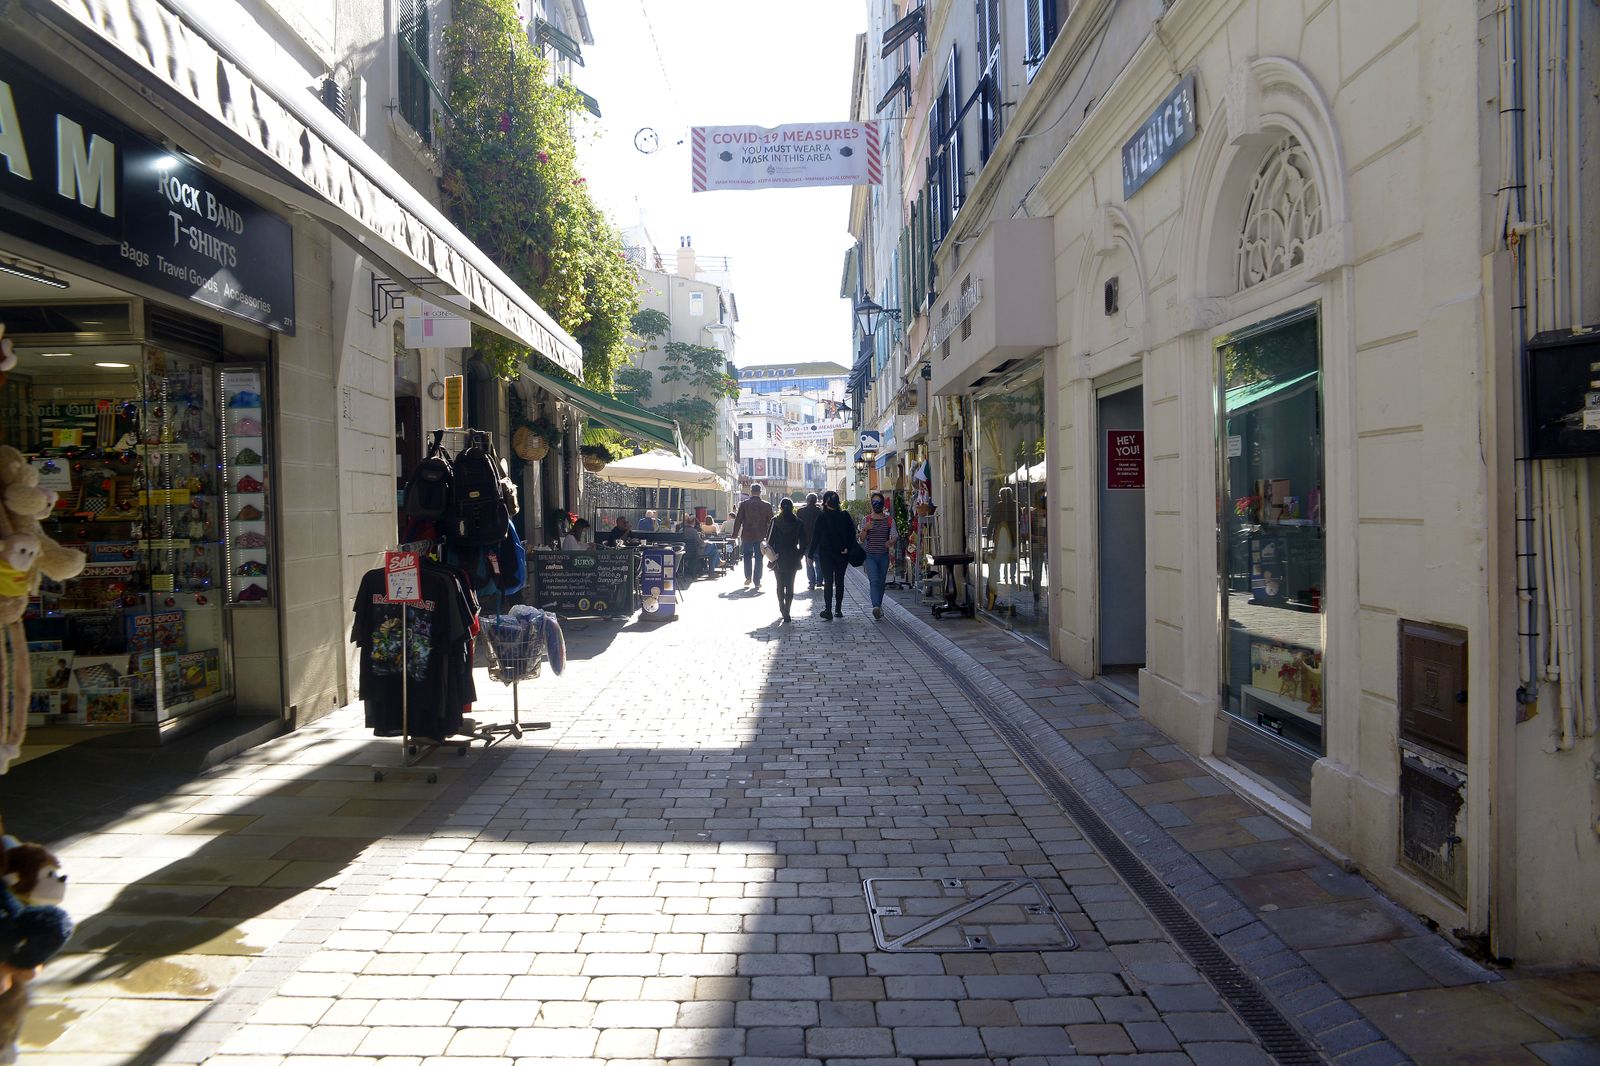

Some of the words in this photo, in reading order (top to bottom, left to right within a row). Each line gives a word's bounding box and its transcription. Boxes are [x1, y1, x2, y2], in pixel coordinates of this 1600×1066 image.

[784, 128, 859, 141] MEASURES
[1129, 94, 1184, 181] VENICE
[742, 146, 762, 154] YOU
[764, 145, 791, 154] MUST
[793, 144, 822, 153] WEAR
[823, 144, 831, 152] A
[742, 154, 769, 164] MASK
[771, 154, 781, 162] IN
[783, 153, 805, 163] THIS
[806, 153, 832, 162] AREA
[158, 169, 202, 217] ROCK
[206, 190, 244, 235] BAND
[169, 210, 237, 268] T-SHIRTS
[120, 242, 150, 267] Bags
[157, 255, 188, 280] Travel
[189, 269, 219, 293] Goods
[223, 283, 272, 314] Accessories
[1117, 435, 1135, 445] HEY
[1116, 445, 1140, 456] YOU!
[390, 554, 415, 569] Sale
[573, 558, 595, 566] JURYS
